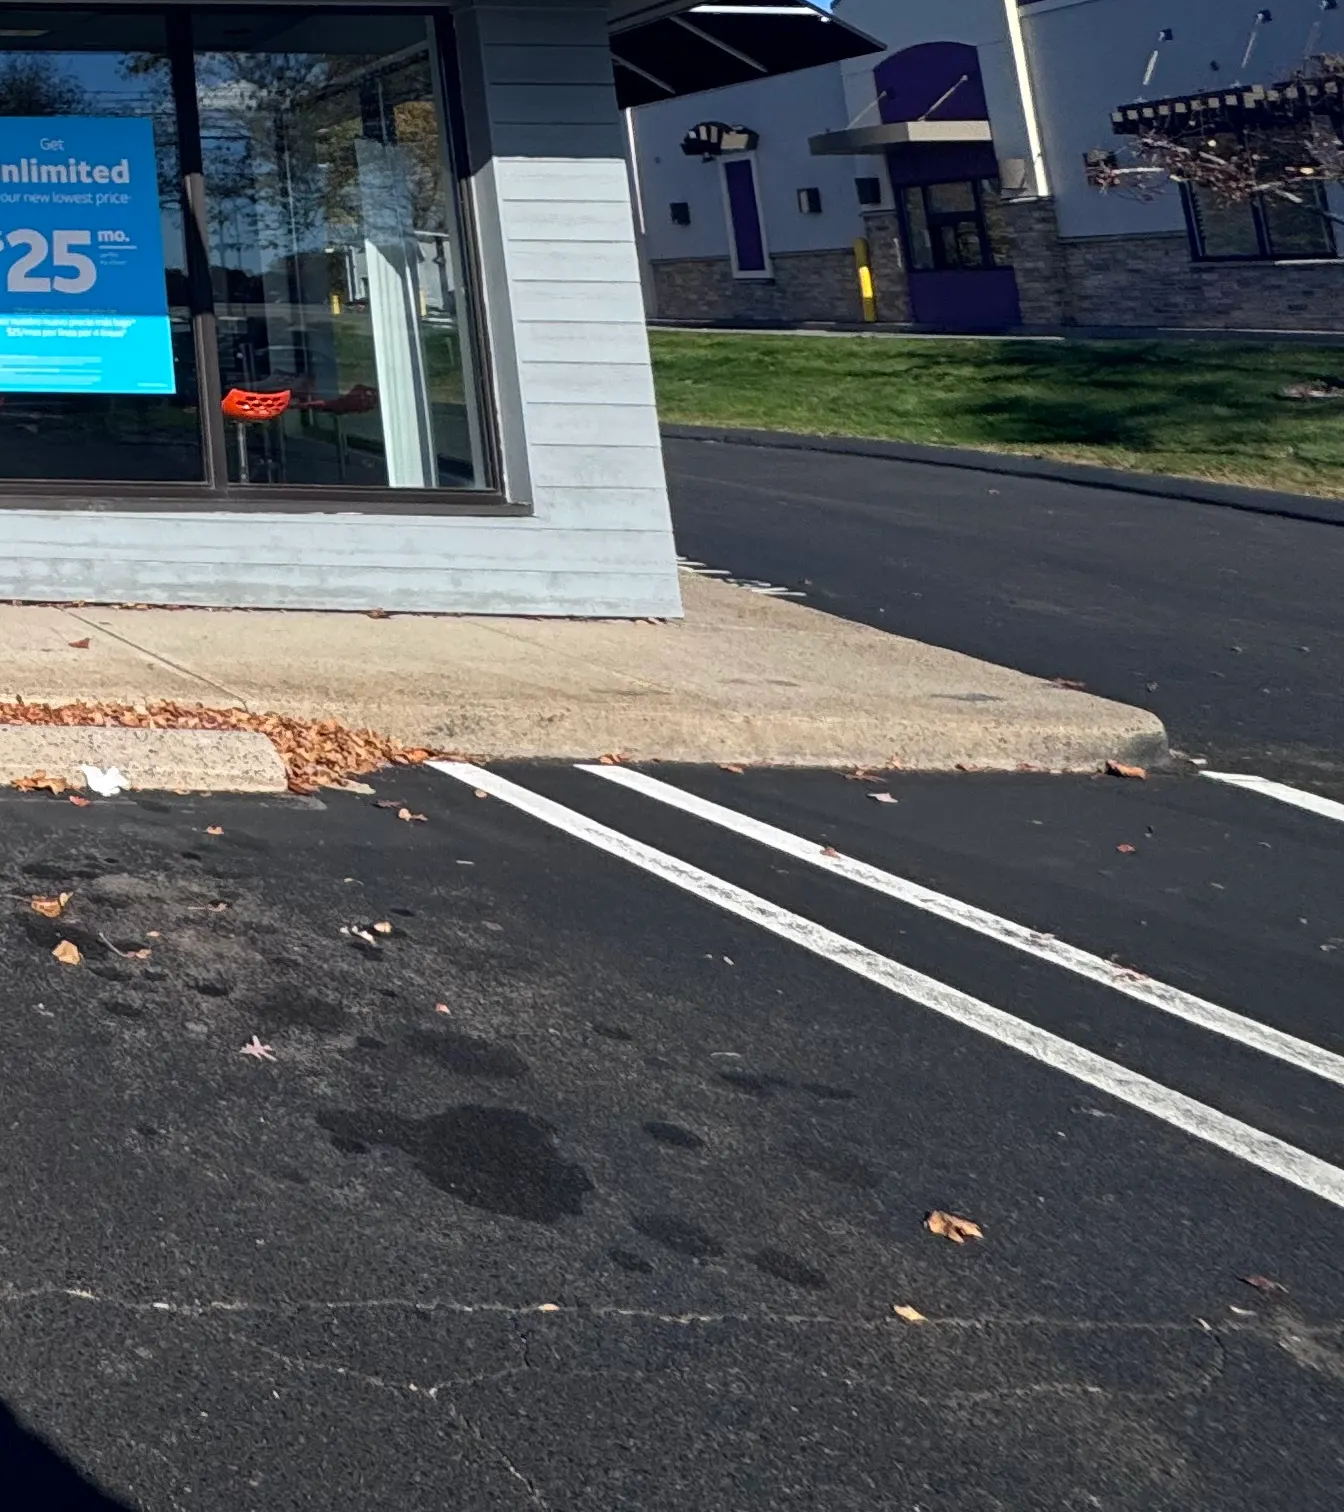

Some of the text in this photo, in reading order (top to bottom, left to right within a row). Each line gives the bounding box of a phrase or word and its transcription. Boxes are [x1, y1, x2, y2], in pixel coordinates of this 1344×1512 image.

[39, 137, 65, 151] Get
[0, 192, 20, 204] our
[23, 192, 51, 204] new
[52, 191, 94, 204] lowest
[98, 229, 130, 243] mo.
